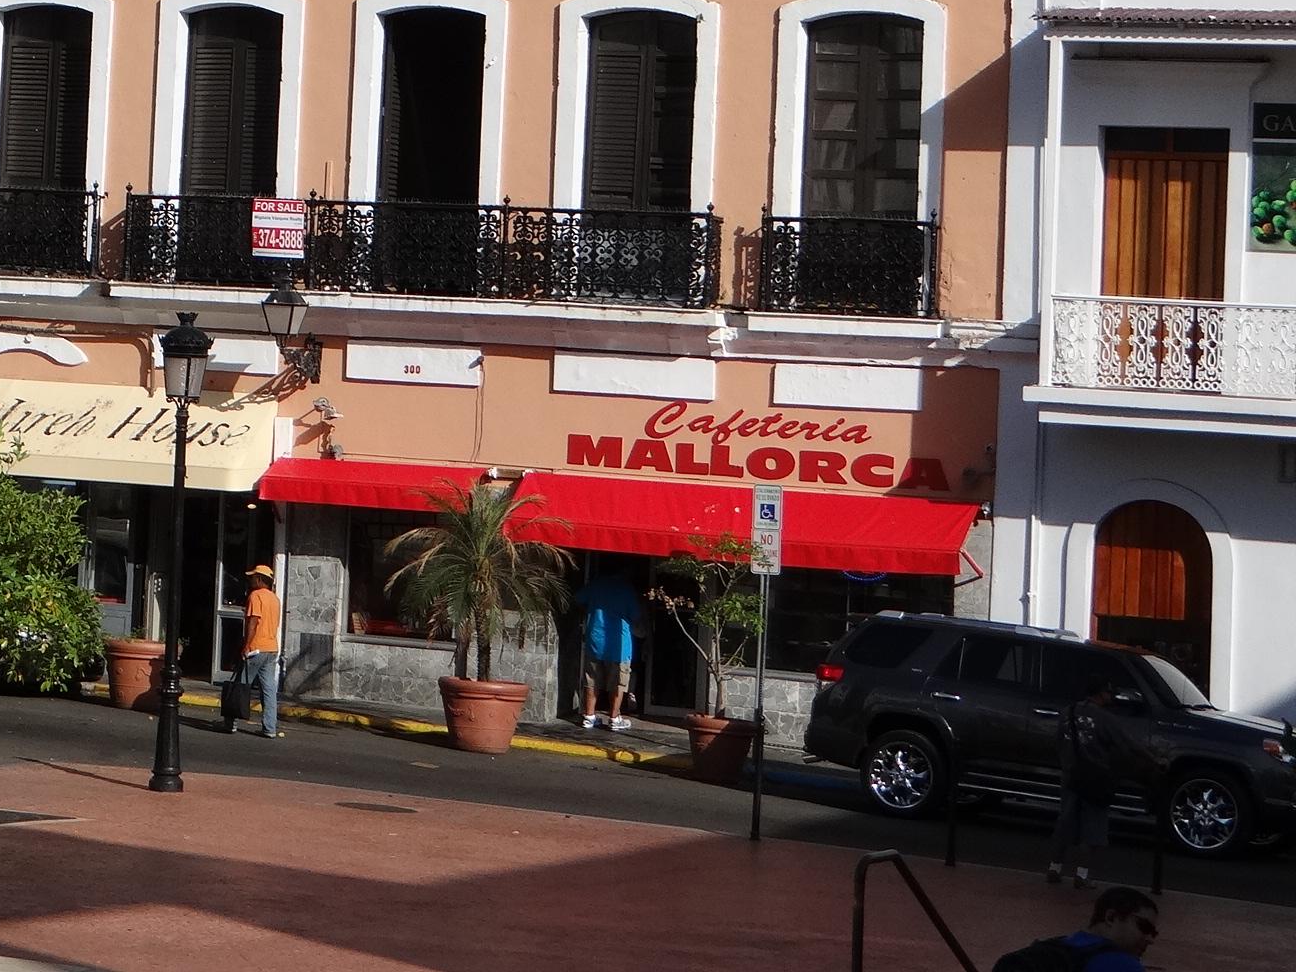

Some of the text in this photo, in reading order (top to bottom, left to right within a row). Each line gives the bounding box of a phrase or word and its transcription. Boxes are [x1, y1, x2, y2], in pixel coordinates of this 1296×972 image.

[1263, 114, 1296, 132] GA
[255, 201, 303, 213] FOR SALE
[258, 229, 303, 249] 374-5888
[404, 365, 421, 374] 300
[107, 406, 251, 447] House
[644, 400, 872, 445] Cafeteria
[567, 434, 951, 491] MALLORCA
[760, 534, 773, 546] NO
